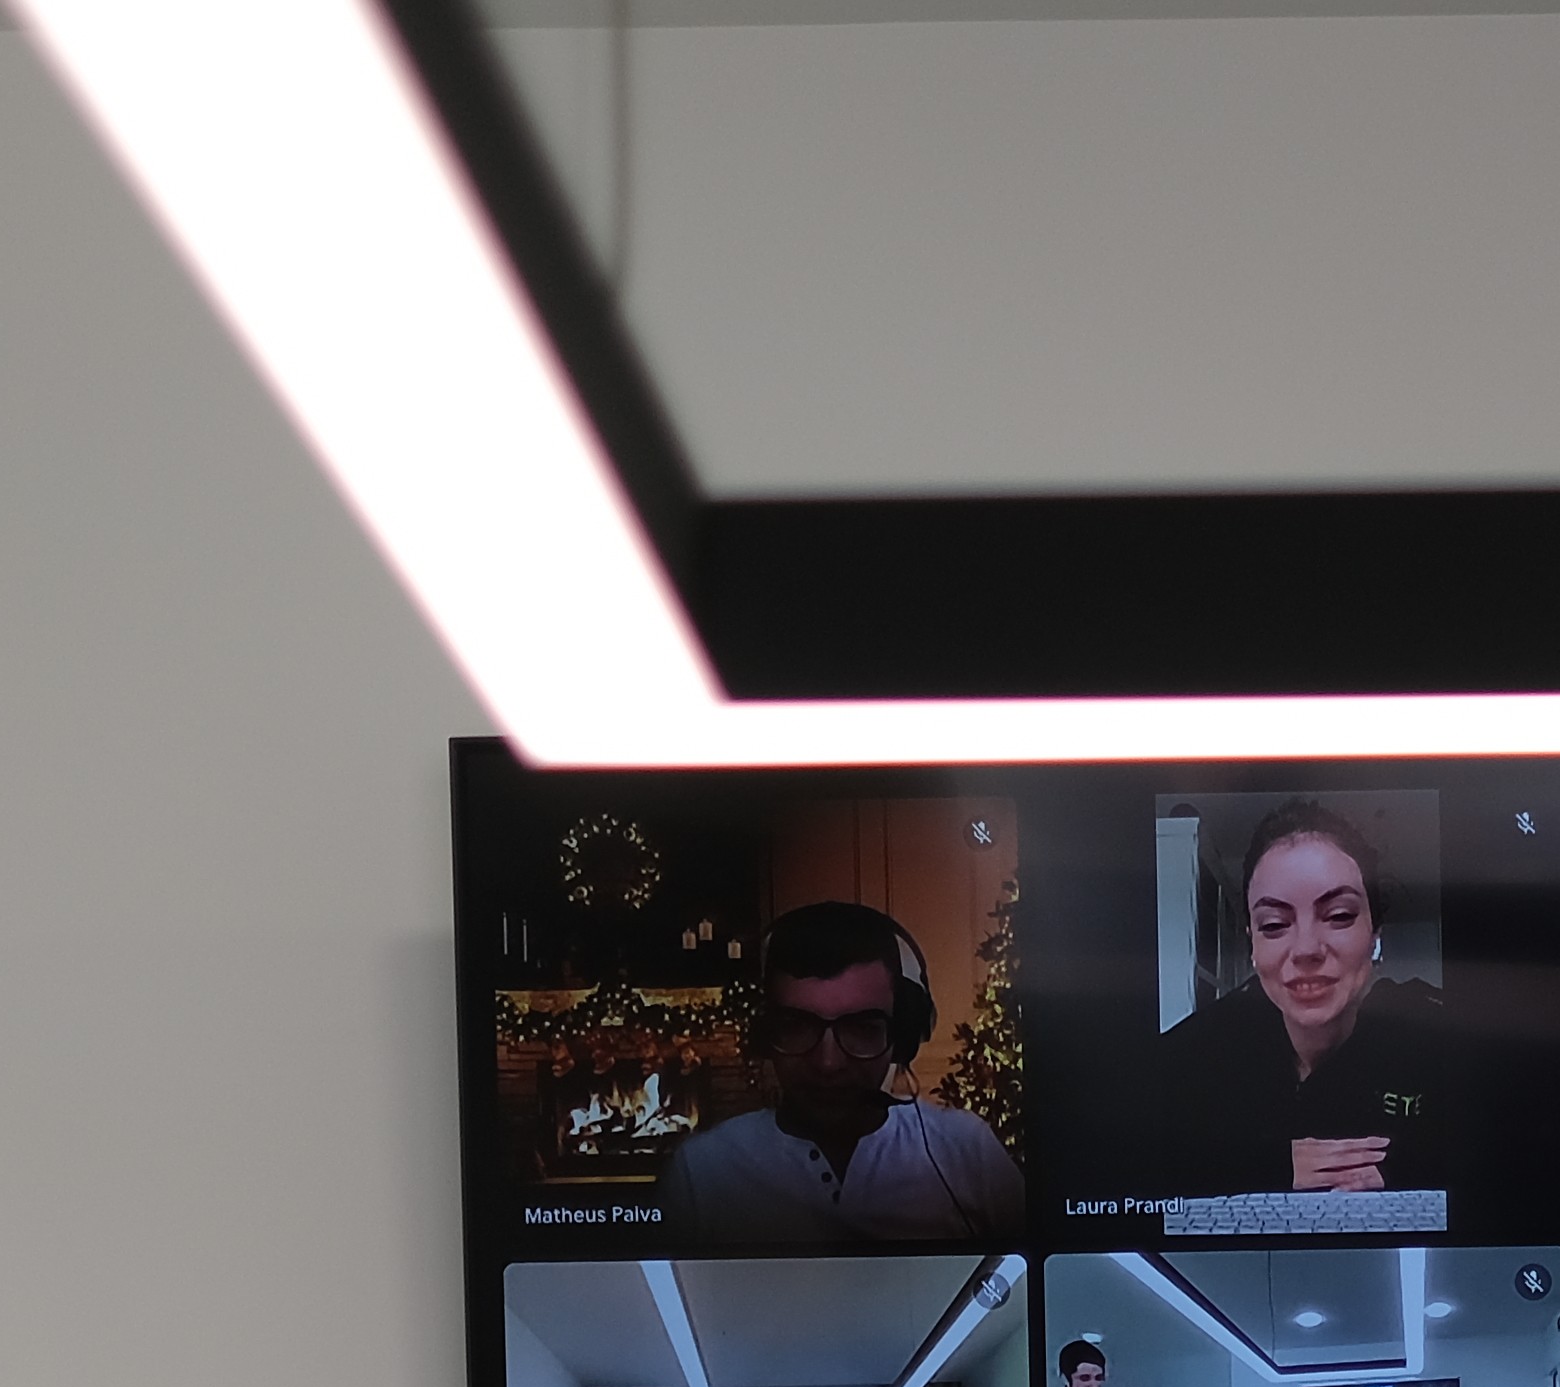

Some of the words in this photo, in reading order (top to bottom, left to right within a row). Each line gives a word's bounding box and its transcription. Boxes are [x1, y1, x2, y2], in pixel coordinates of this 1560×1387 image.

[1066, 1198, 1118, 1215] Laura
[1124, 1196, 1184, 1214] Prandi
[524, 1207, 606, 1224] Matheus
